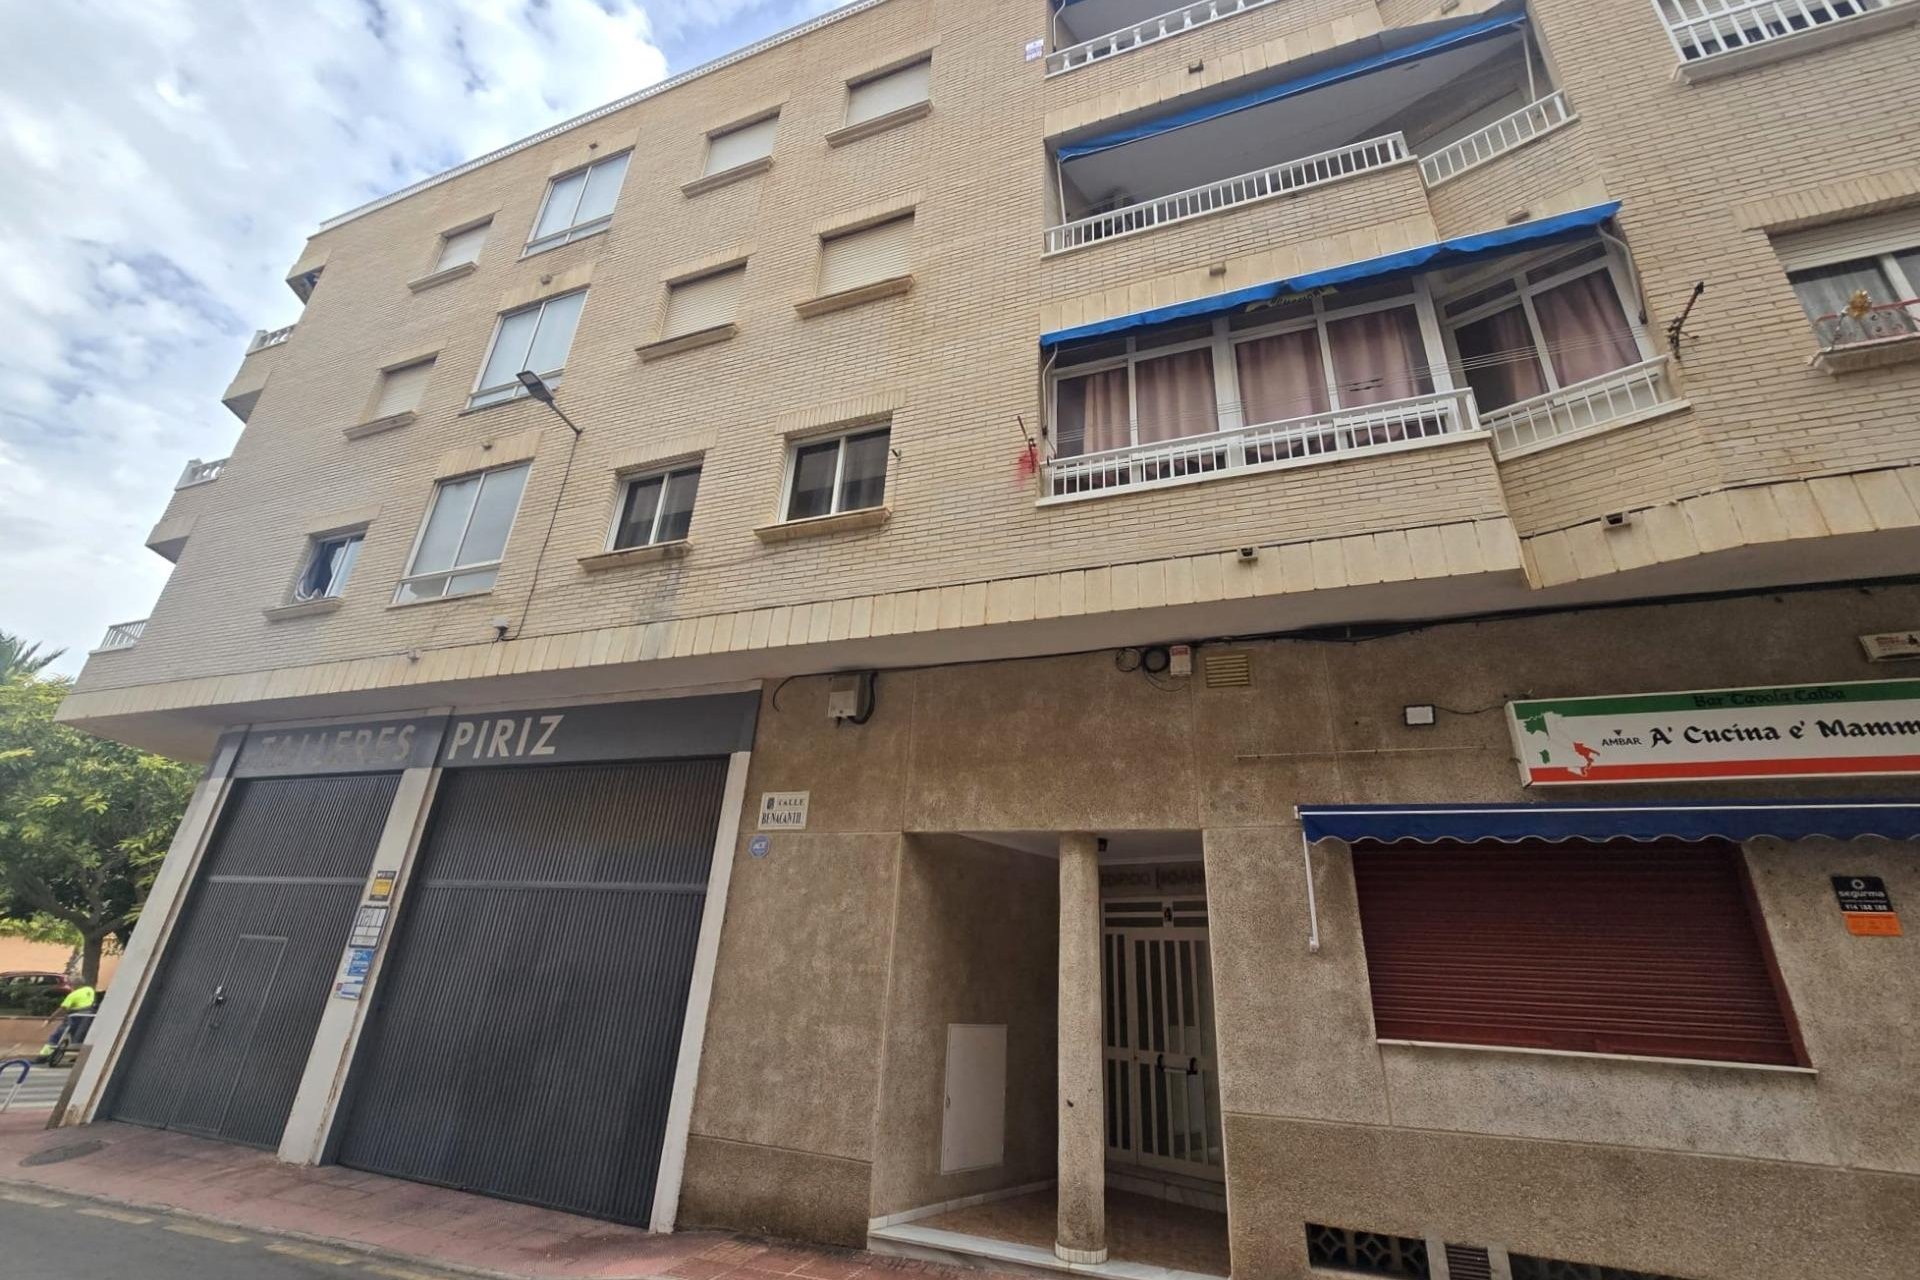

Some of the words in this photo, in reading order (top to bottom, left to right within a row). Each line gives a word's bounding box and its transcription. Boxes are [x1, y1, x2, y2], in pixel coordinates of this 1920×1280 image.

[261, 724, 417, 769] TALLERES
[447, 714, 565, 760] PIRIZ
[1601, 736, 1643, 747] AMBAR
[1683, 723, 1781, 744] Cucina
